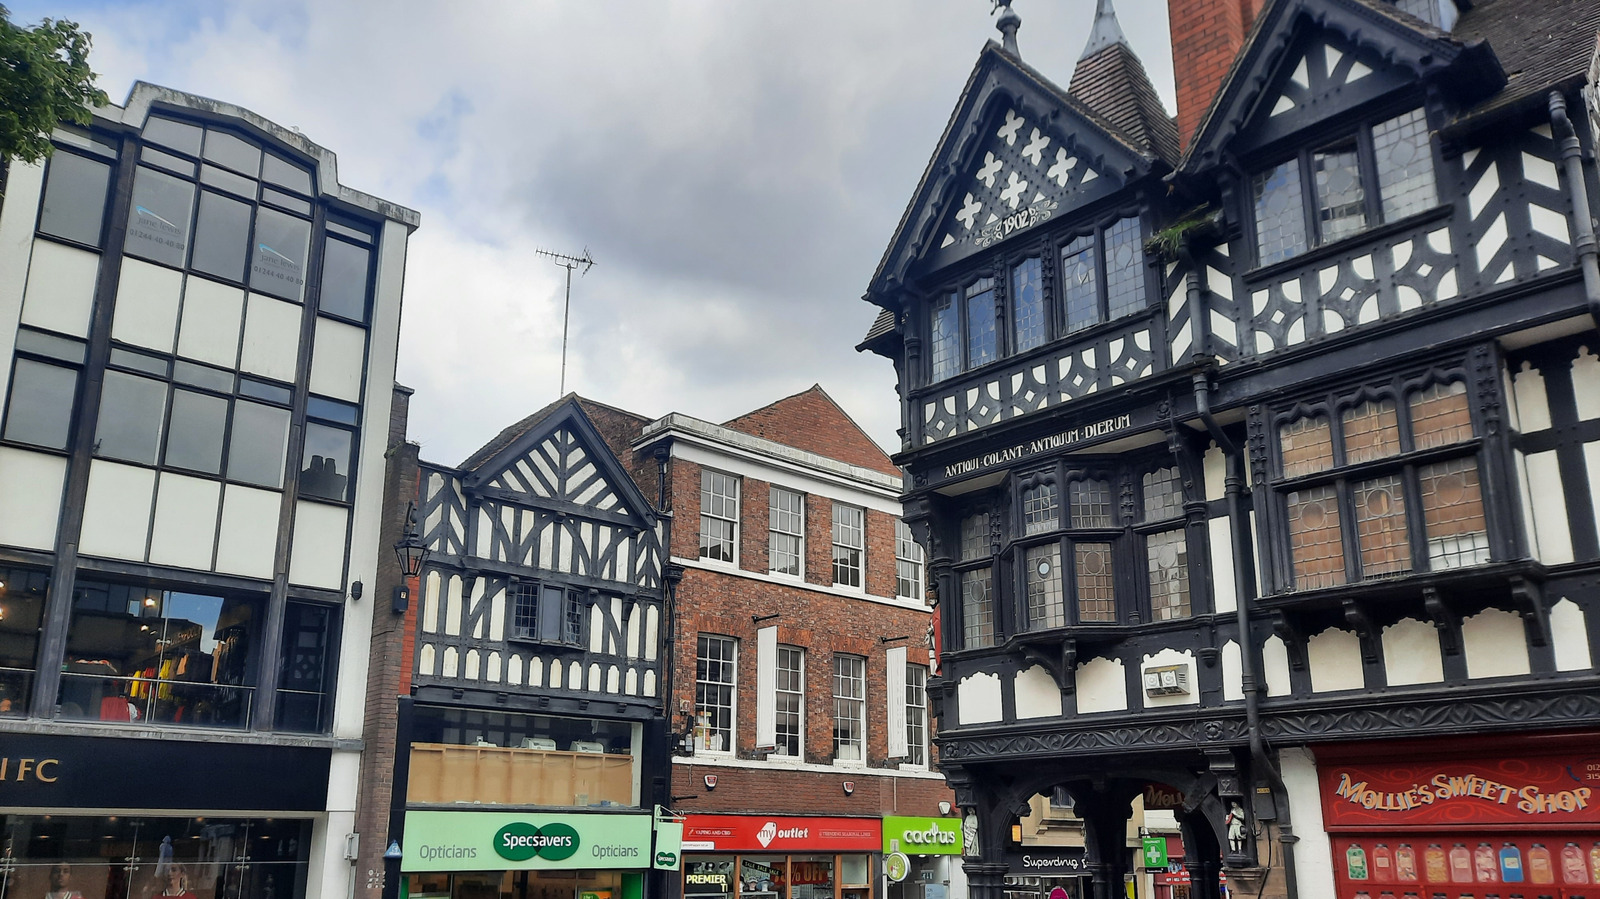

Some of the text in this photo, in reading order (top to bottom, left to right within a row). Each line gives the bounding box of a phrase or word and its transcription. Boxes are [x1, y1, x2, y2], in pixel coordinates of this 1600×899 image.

[1003, 210, 1029, 235] 1902
[130, 229, 152, 240] 01244
[154, 236, 163, 244] 40
[254, 266, 274, 277] 01244
[944, 413, 1131, 478] ANTIQUI COLANT ANTIQUUM DIERUM
[1432, 773, 1517, 805] SWEET
[1517, 785, 1592, 813] SHOP
[503, 832, 572, 849] Specsavers
[760, 828, 808, 840] my outlet
[903, 821, 956, 844] cactus
[420, 844, 477, 861] Opticians
[592, 844, 639, 860] Opticians
[1023, 855, 1079, 870] Superdrug
[686, 874, 726, 884] PREMIER
